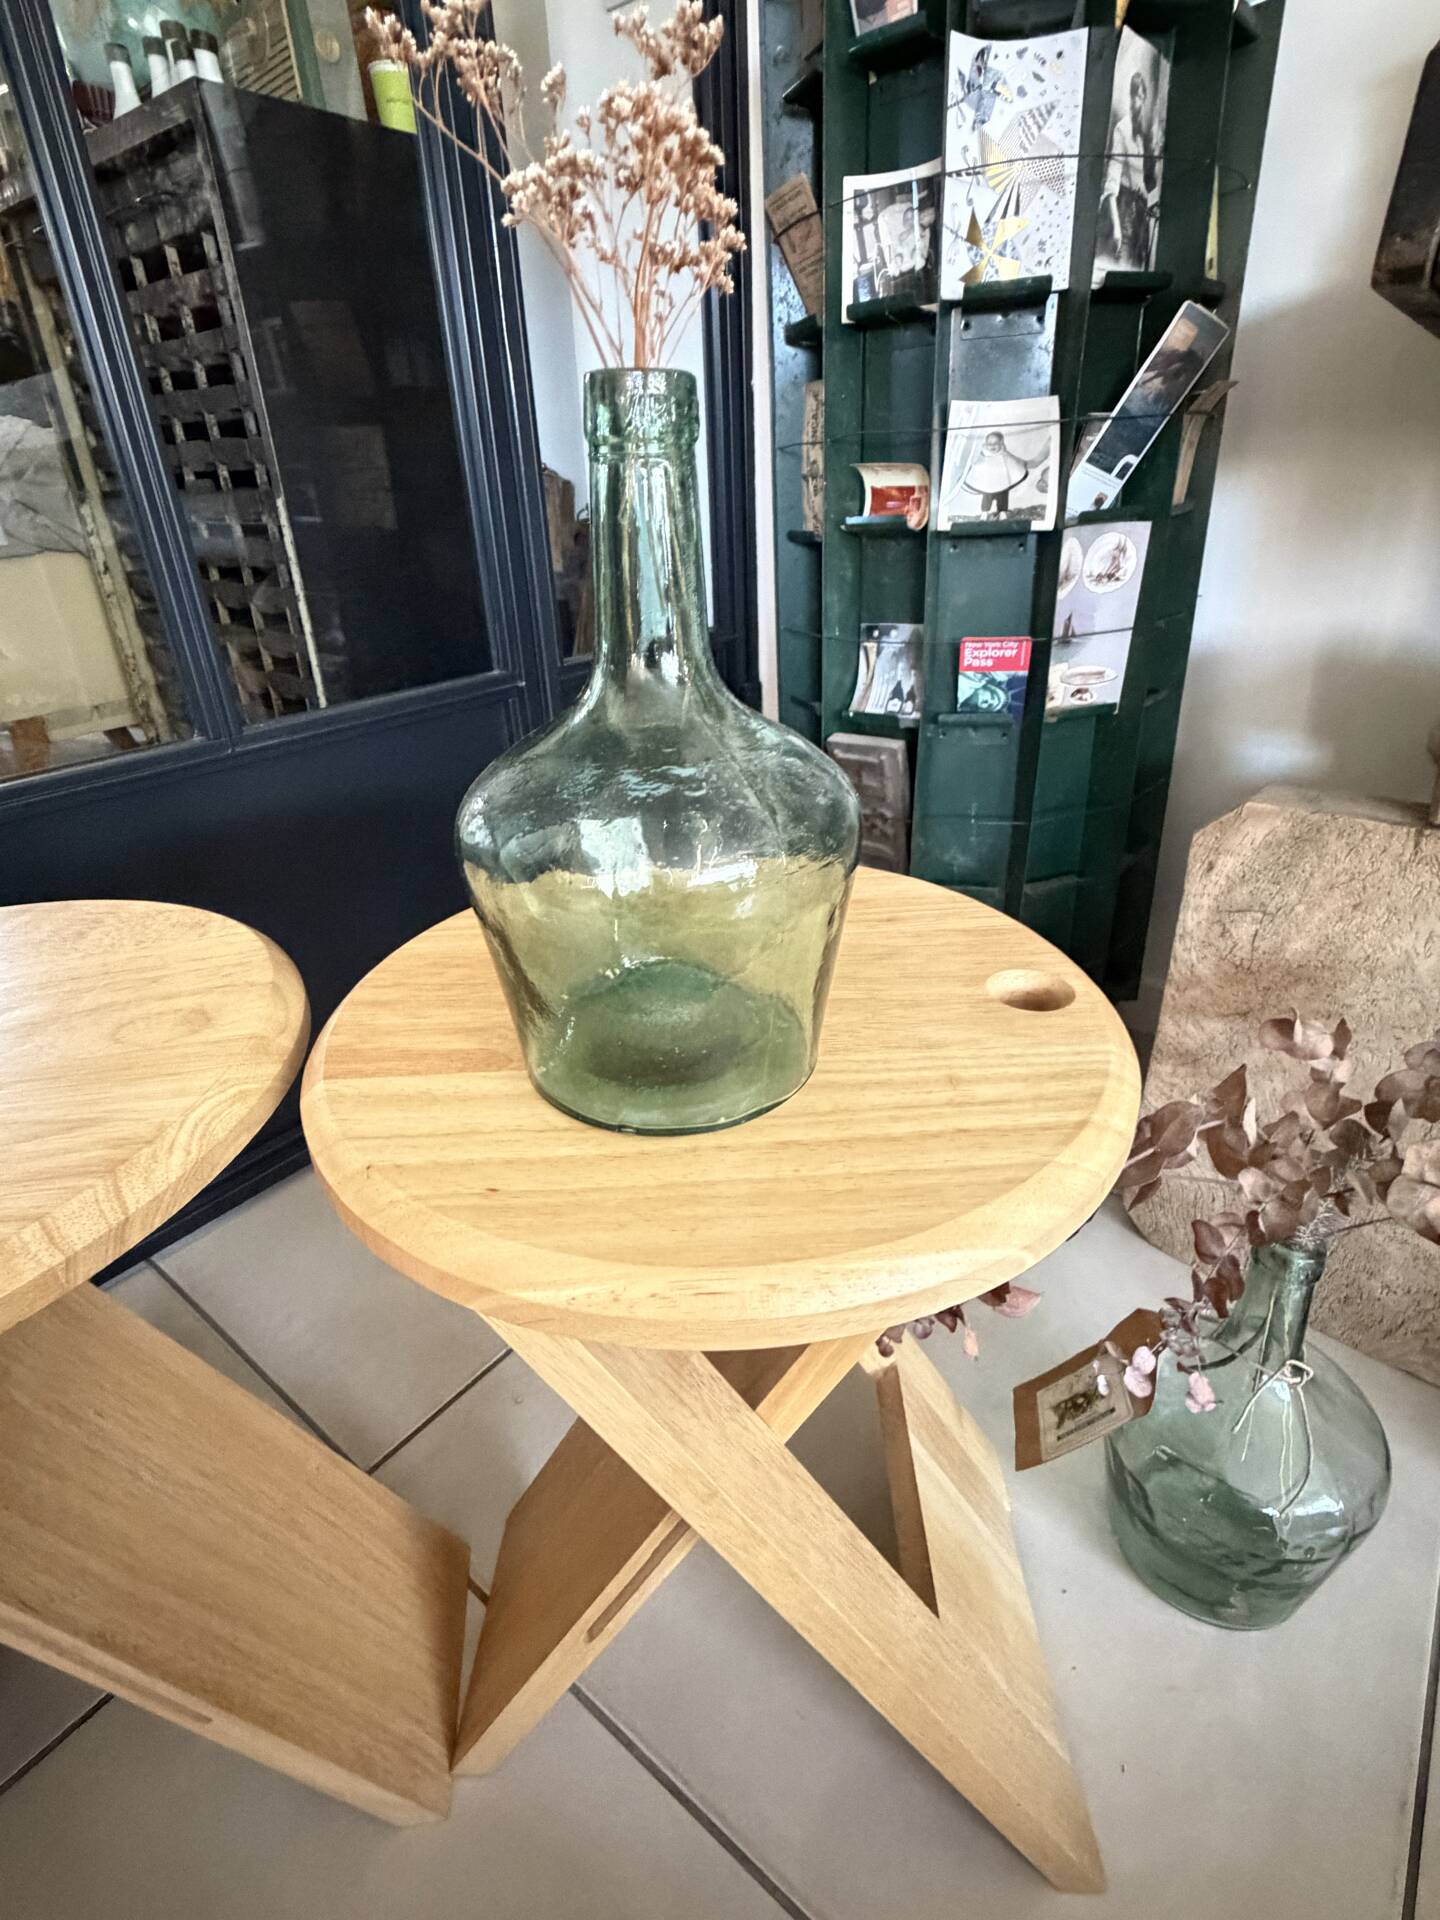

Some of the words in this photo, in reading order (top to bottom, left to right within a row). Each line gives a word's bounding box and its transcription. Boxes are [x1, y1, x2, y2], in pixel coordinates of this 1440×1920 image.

[1002, 640, 1019, 649] City
[964, 647, 1018, 659] Explorer
[963, 657, 993, 667] Pass
